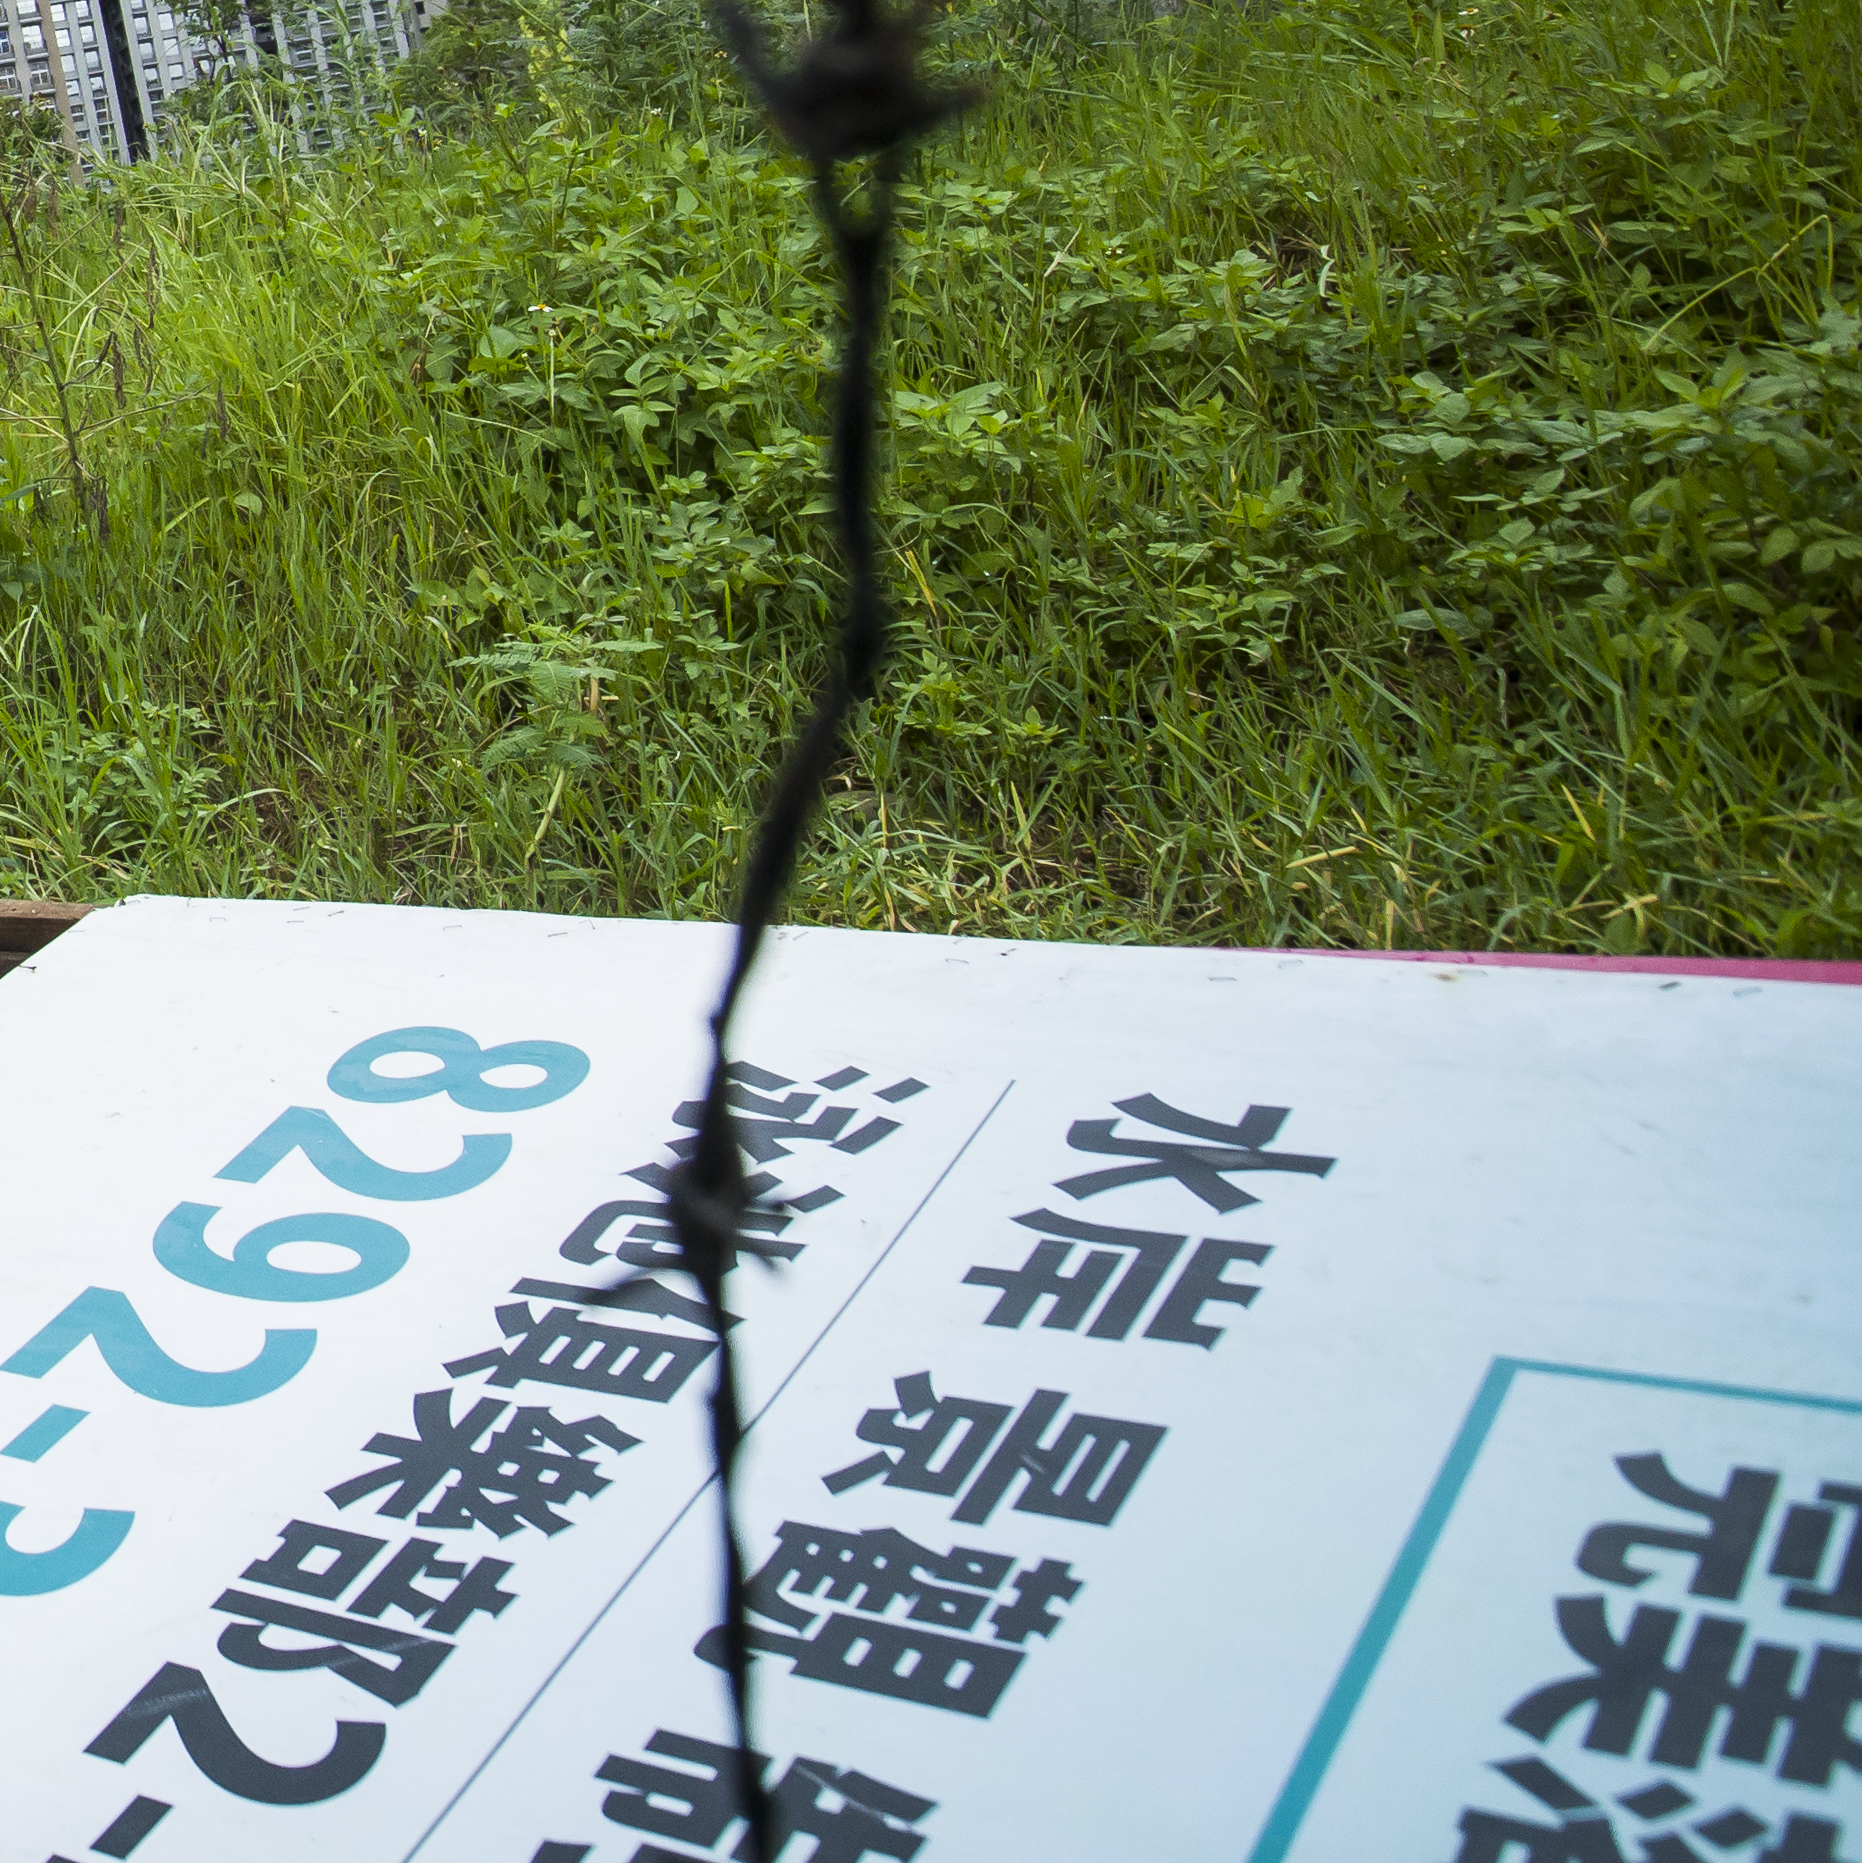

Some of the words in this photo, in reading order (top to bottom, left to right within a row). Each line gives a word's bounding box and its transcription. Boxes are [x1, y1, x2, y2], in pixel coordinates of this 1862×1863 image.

[963, 1092, 1337, 1350] 水岸
[45, 1059, 931, 1863] 泳池俱樂部2-
[694, 1370, 1169, 1720] 景觀
